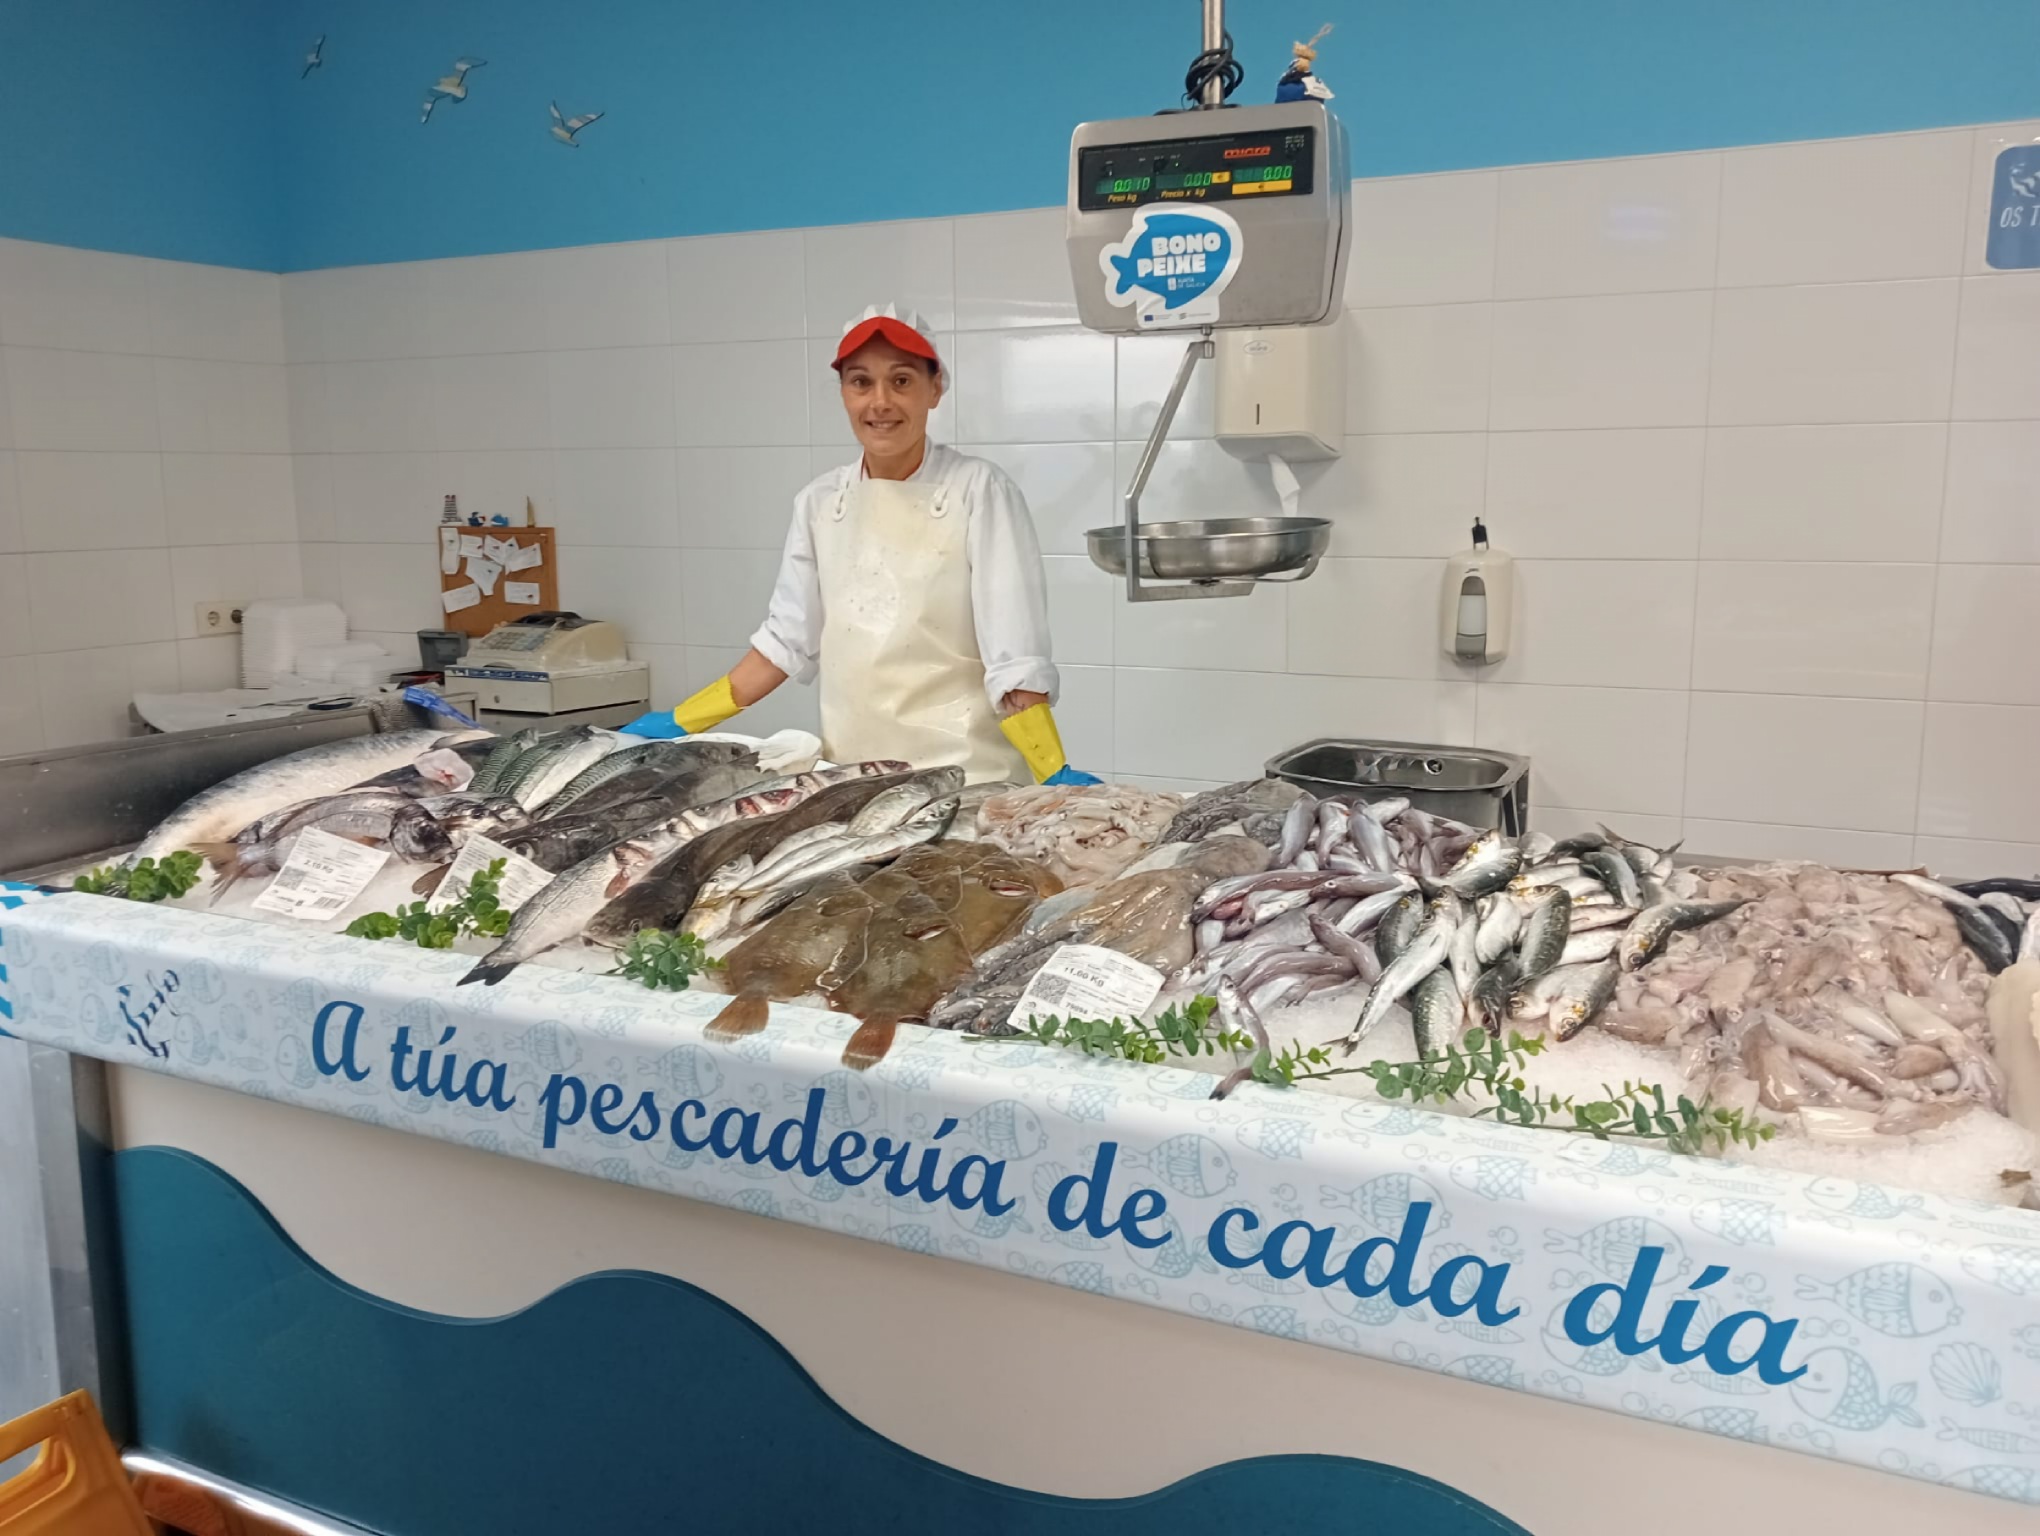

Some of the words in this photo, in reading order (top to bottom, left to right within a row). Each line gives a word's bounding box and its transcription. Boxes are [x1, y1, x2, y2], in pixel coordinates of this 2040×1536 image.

[2000, 205, 2024, 228] OS
[2030, 204, 2040, 227] T
[1151, 232, 1222, 257] BONO
[1137, 253, 1206, 278] PEIXE
[312, 1001, 371, 1082] A
[390, 1025, 516, 1112] túa
[539, 1073, 1017, 1217] pescadería
[1047, 1142, 1173, 1249] de
[1207, 1201, 1520, 1327] cada
[1563, 1246, 1808, 1385] día
